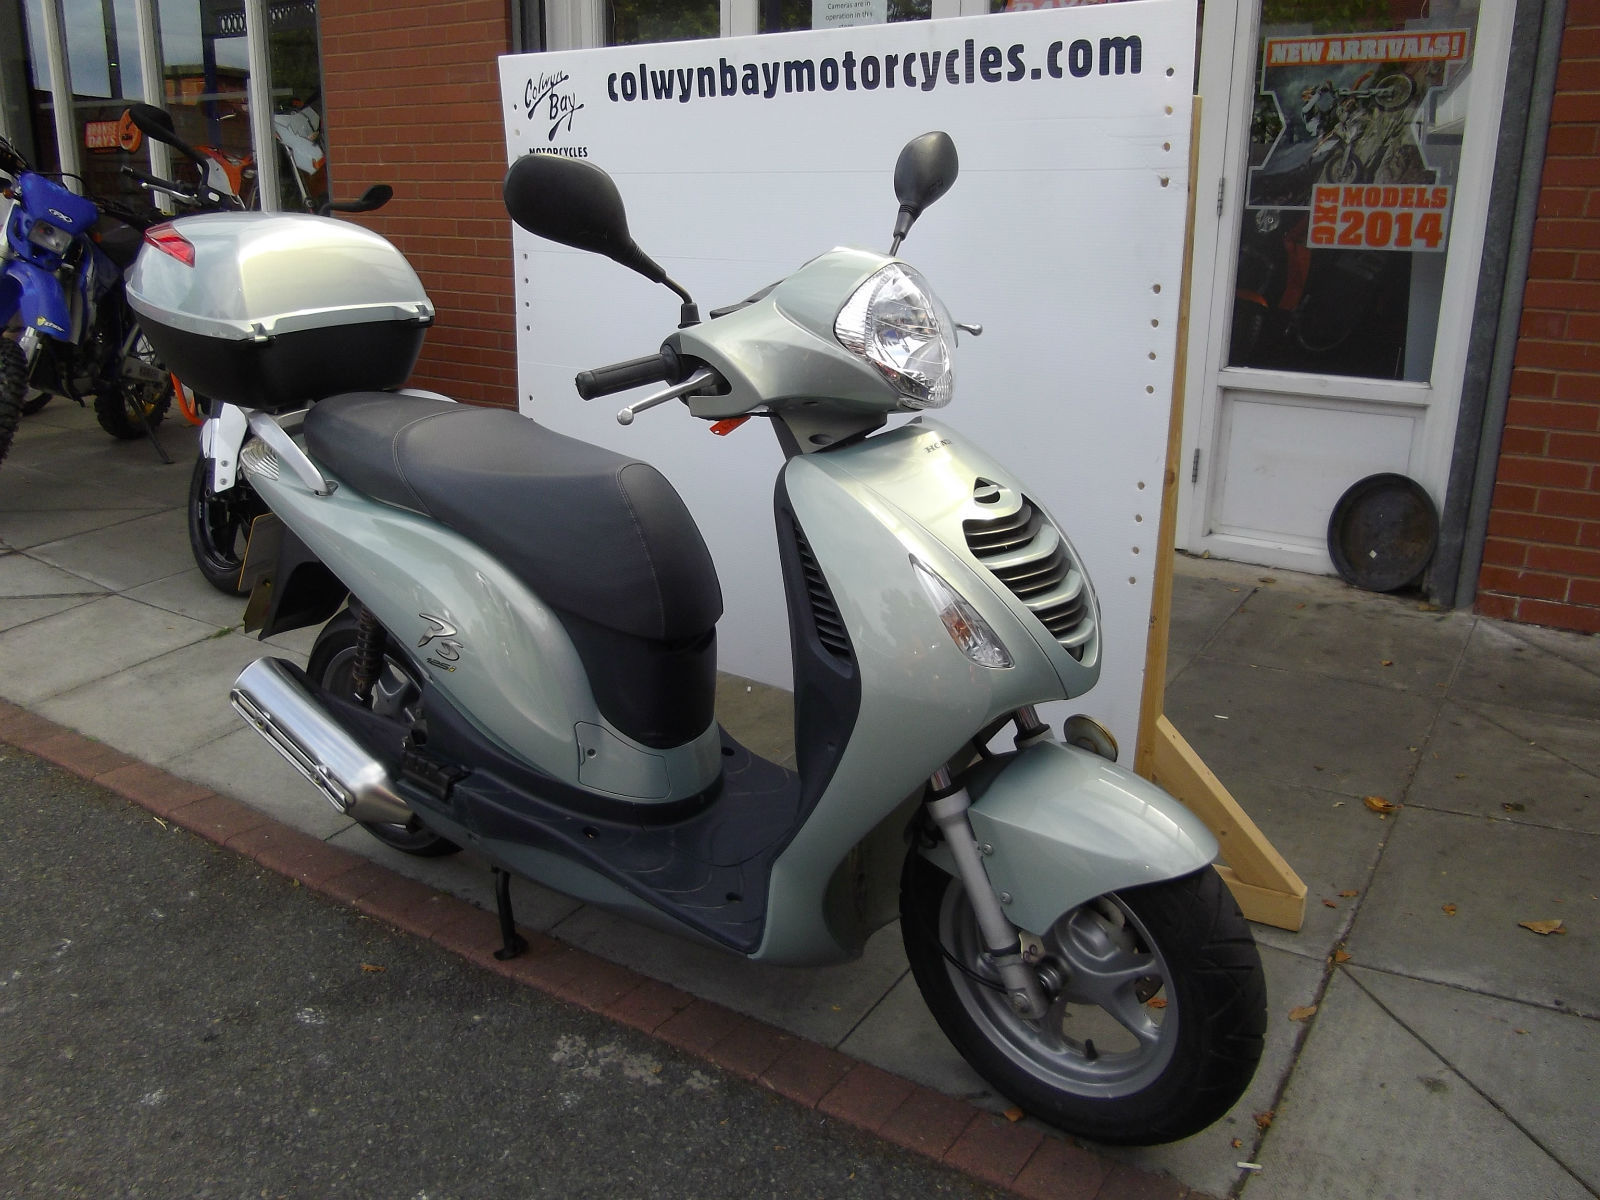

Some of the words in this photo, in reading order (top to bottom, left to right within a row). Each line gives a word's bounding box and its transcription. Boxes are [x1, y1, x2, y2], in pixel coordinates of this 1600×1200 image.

[825, 12, 854, 21] operation
[827, 2, 853, 10] Cameras
[1270, 40, 1325, 64] NEW
[1326, 35, 1462, 62] ARRIVALS!
[607, 35, 1142, 104] colwynbaymotorcycles.com
[524, 70, 569, 112] Colwyn
[548, 92, 584, 138] Bay
[1310, 186, 1341, 246] EXC
[1341, 186, 1449, 210] MODELS
[1337, 210, 1443, 249] 2014
